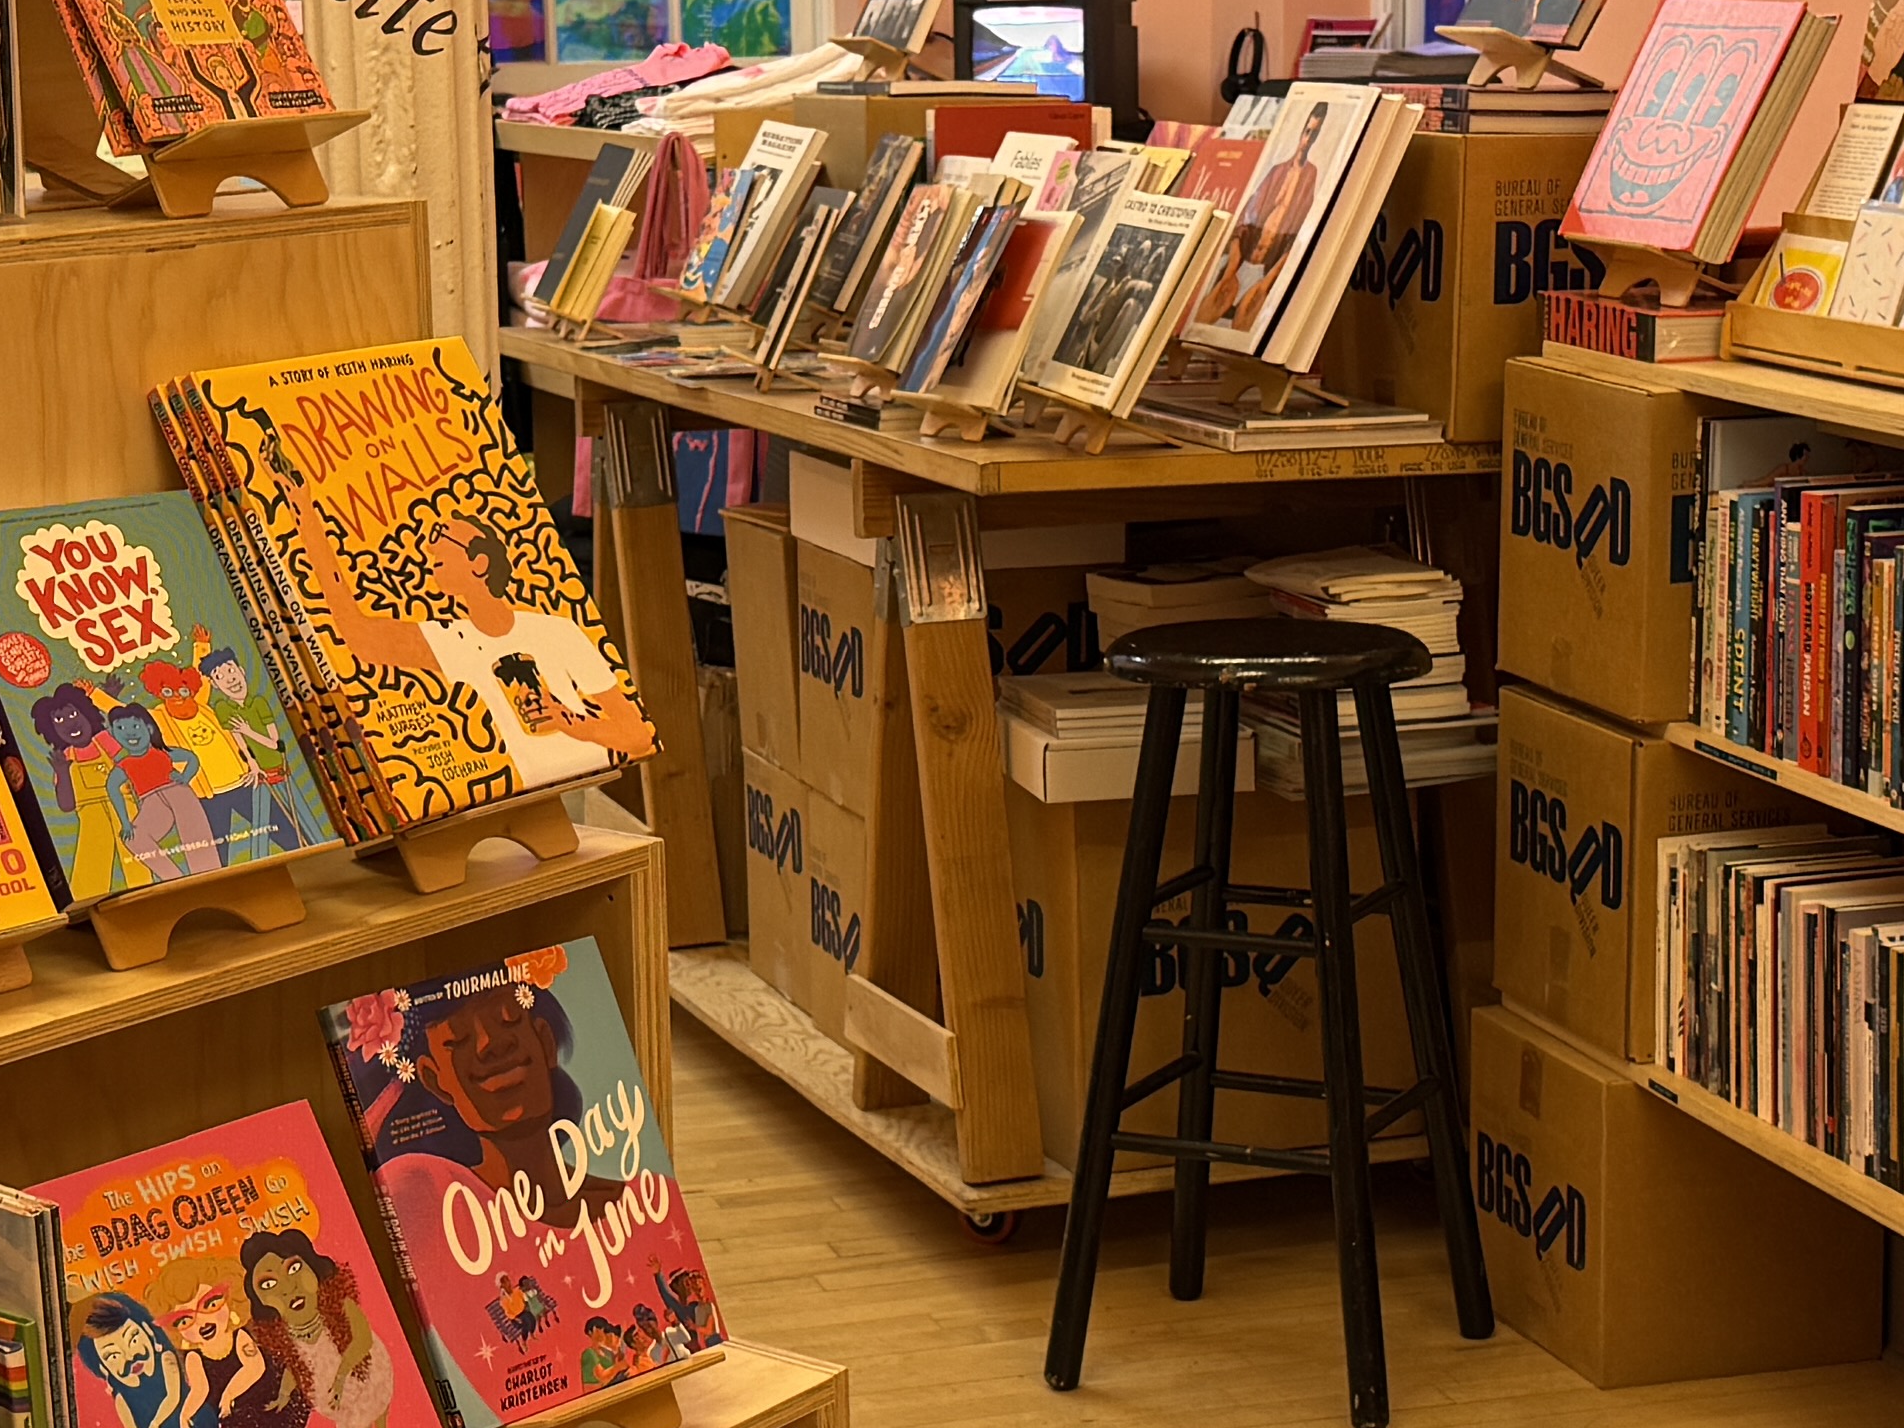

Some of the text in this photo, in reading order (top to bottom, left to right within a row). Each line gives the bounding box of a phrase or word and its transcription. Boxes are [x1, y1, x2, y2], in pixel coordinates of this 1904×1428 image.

[172, 20, 226, 34] HISTORY
[1548, 291, 1638, 358] HARING
[269, 353, 414, 387] A STORY OF KEITH HARING
[281, 368, 450, 484] DRAWING
[365, 435, 395, 459] ON
[326, 415, 473, 541] WALLS
[31, 531, 117, 574] YOU
[24, 556, 159, 630] KNOW,
[74, 599, 172, 666] SEX
[443, 963, 532, 1000] TOURMALINE
[103, 1161, 222, 1210] The HIPS on
[442, 1080, 645, 1277] One Day
[62, 1174, 287, 1261] he DRAG QUEEN Go
[537, 1168, 670, 1308] in June
[500, 1376, 568, 1411] KRISTENSEN
[504, 1363, 554, 1393] CHARLOT
